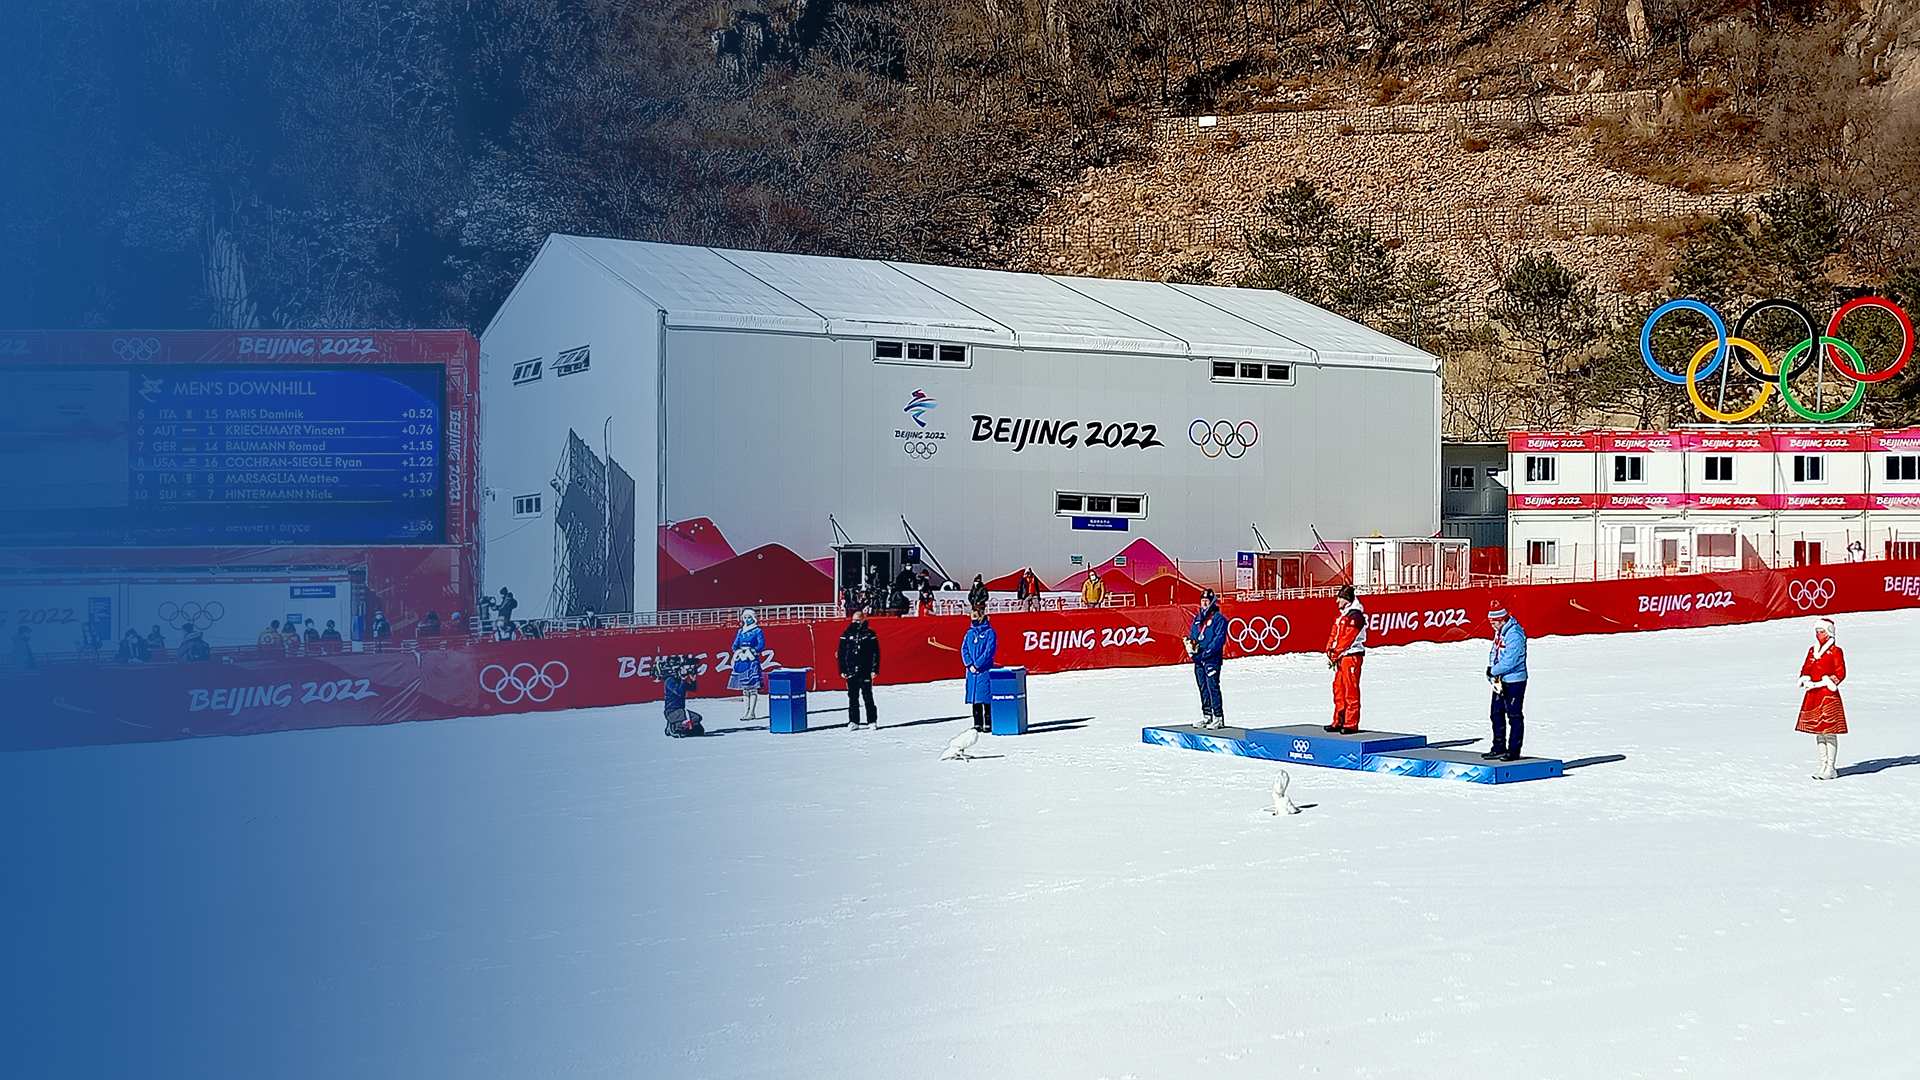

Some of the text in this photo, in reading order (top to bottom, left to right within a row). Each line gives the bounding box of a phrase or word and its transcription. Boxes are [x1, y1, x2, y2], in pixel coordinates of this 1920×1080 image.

[0, 338, 33, 354] 22
[238, 336, 380, 359] BEIJING 2022
[173, 381, 317, 396] MEN'S DOWNHILL
[137, 408, 433, 419] 5 ITA 15 PARIS Dominik +0.52
[137, 424, 433, 435] 6 AUT 1 KRIECHMAYR Vincent +0.76
[894, 430, 947, 440] BEIJING 2022
[970, 414, 1166, 452] BEIJING 2022
[137, 441, 145, 451] 7
[152, 441, 177, 451] GER
[204, 441, 218, 451] 14
[225, 441, 285, 451] BAUMANN
[402, 440, 433, 451] +1.15
[1527, 439, 1586, 449] BEIJING 2022
[1614, 439, 1673, 449] BEIJING 2022
[1701, 439, 1761, 449] BEIJING 2022
[1789, 439, 1850, 449] BEIJING 2022
[137, 456, 433, 469] 8 USA 16 COCHRAN-SIEGLE Ryan +1.22
[137, 472, 433, 484] 9 ITA 8 MARSAGLIA Matteo +1.37
[134, 489, 148, 499] 10
[158, 489, 177, 499] SUI
[207, 489, 215, 499] 7
[225, 489, 304, 499] HINTERMANN
[1524, 497, 1582, 507] BEIJING 2022
[1611, 497, 1670, 507] BEIJING 2022
[1699, 497, 1759, 507] BEIJING 2022
[1787, 497, 1847, 507] BEIJING 2022
[1638, 591, 1736, 617] BEIJING 2022
[17, 607, 80, 626] 2022
[1423, 608, 1471, 628] 2022
[1022, 626, 1156, 656] BEIJING 2022
[714, 649, 782, 673] 22
[187, 678, 379, 717] BEIJING 2022
